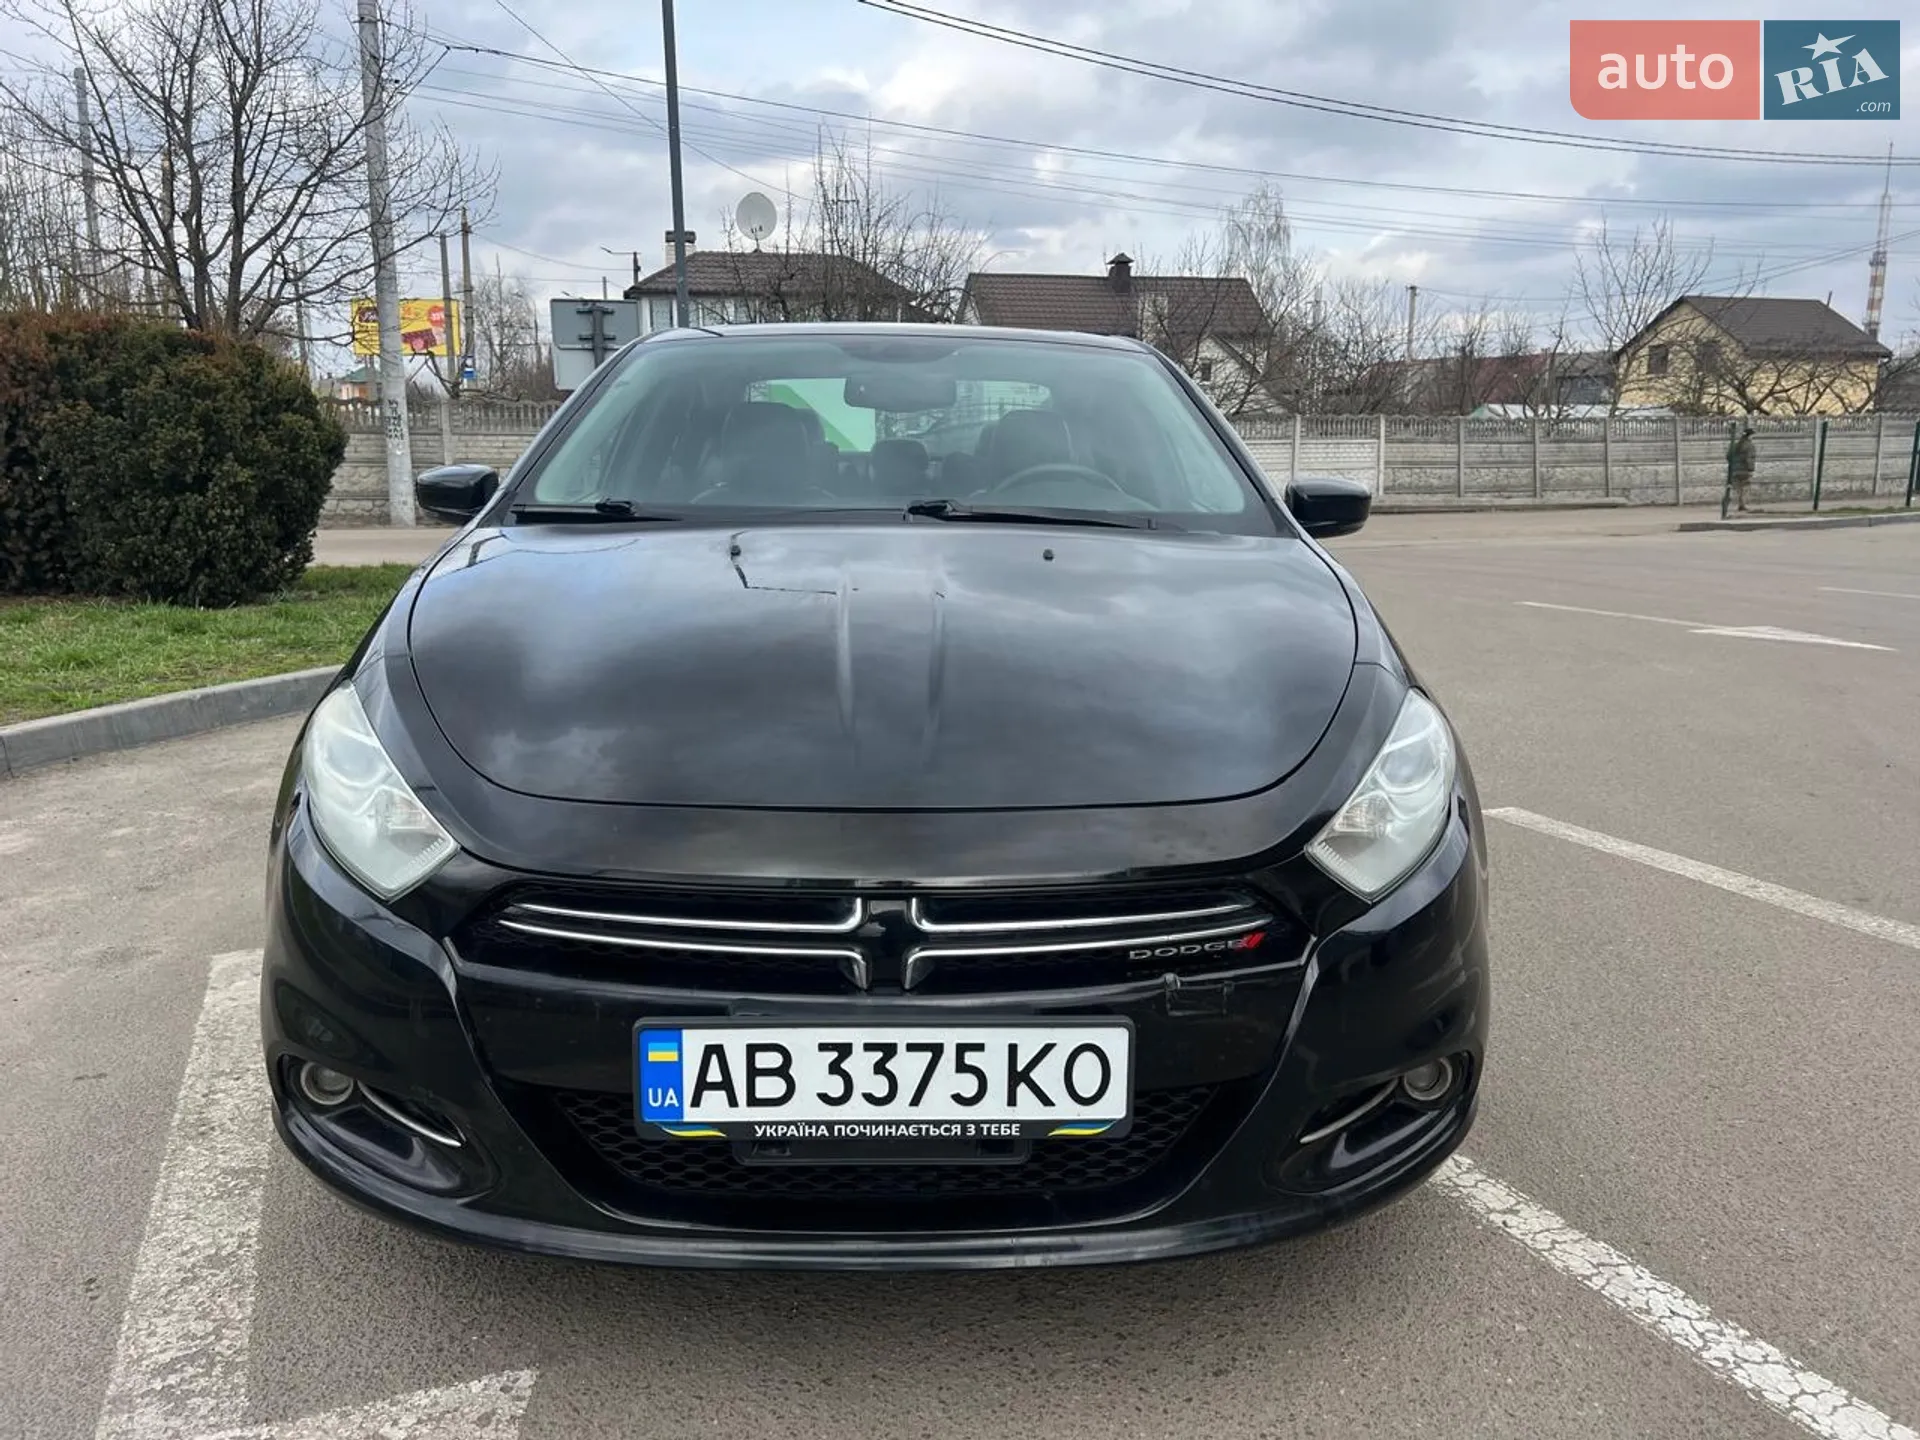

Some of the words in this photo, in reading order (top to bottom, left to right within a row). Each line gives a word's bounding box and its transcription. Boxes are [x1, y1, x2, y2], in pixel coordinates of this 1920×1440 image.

[1129, 939, 1247, 960] DODGE
[689, 1042, 797, 1108] AB
[816, 1042, 989, 1108] 3375
[1007, 1042, 1112, 1108] KO
[648, 1087, 679, 1108] UA
[754, 1122, 829, 1137] УКРАЇНА
[834, 1124, 962, 1137] ПОЧИНАЄТЬСЯ
[980, 1123, 1021, 1136] ТЕБЕ
